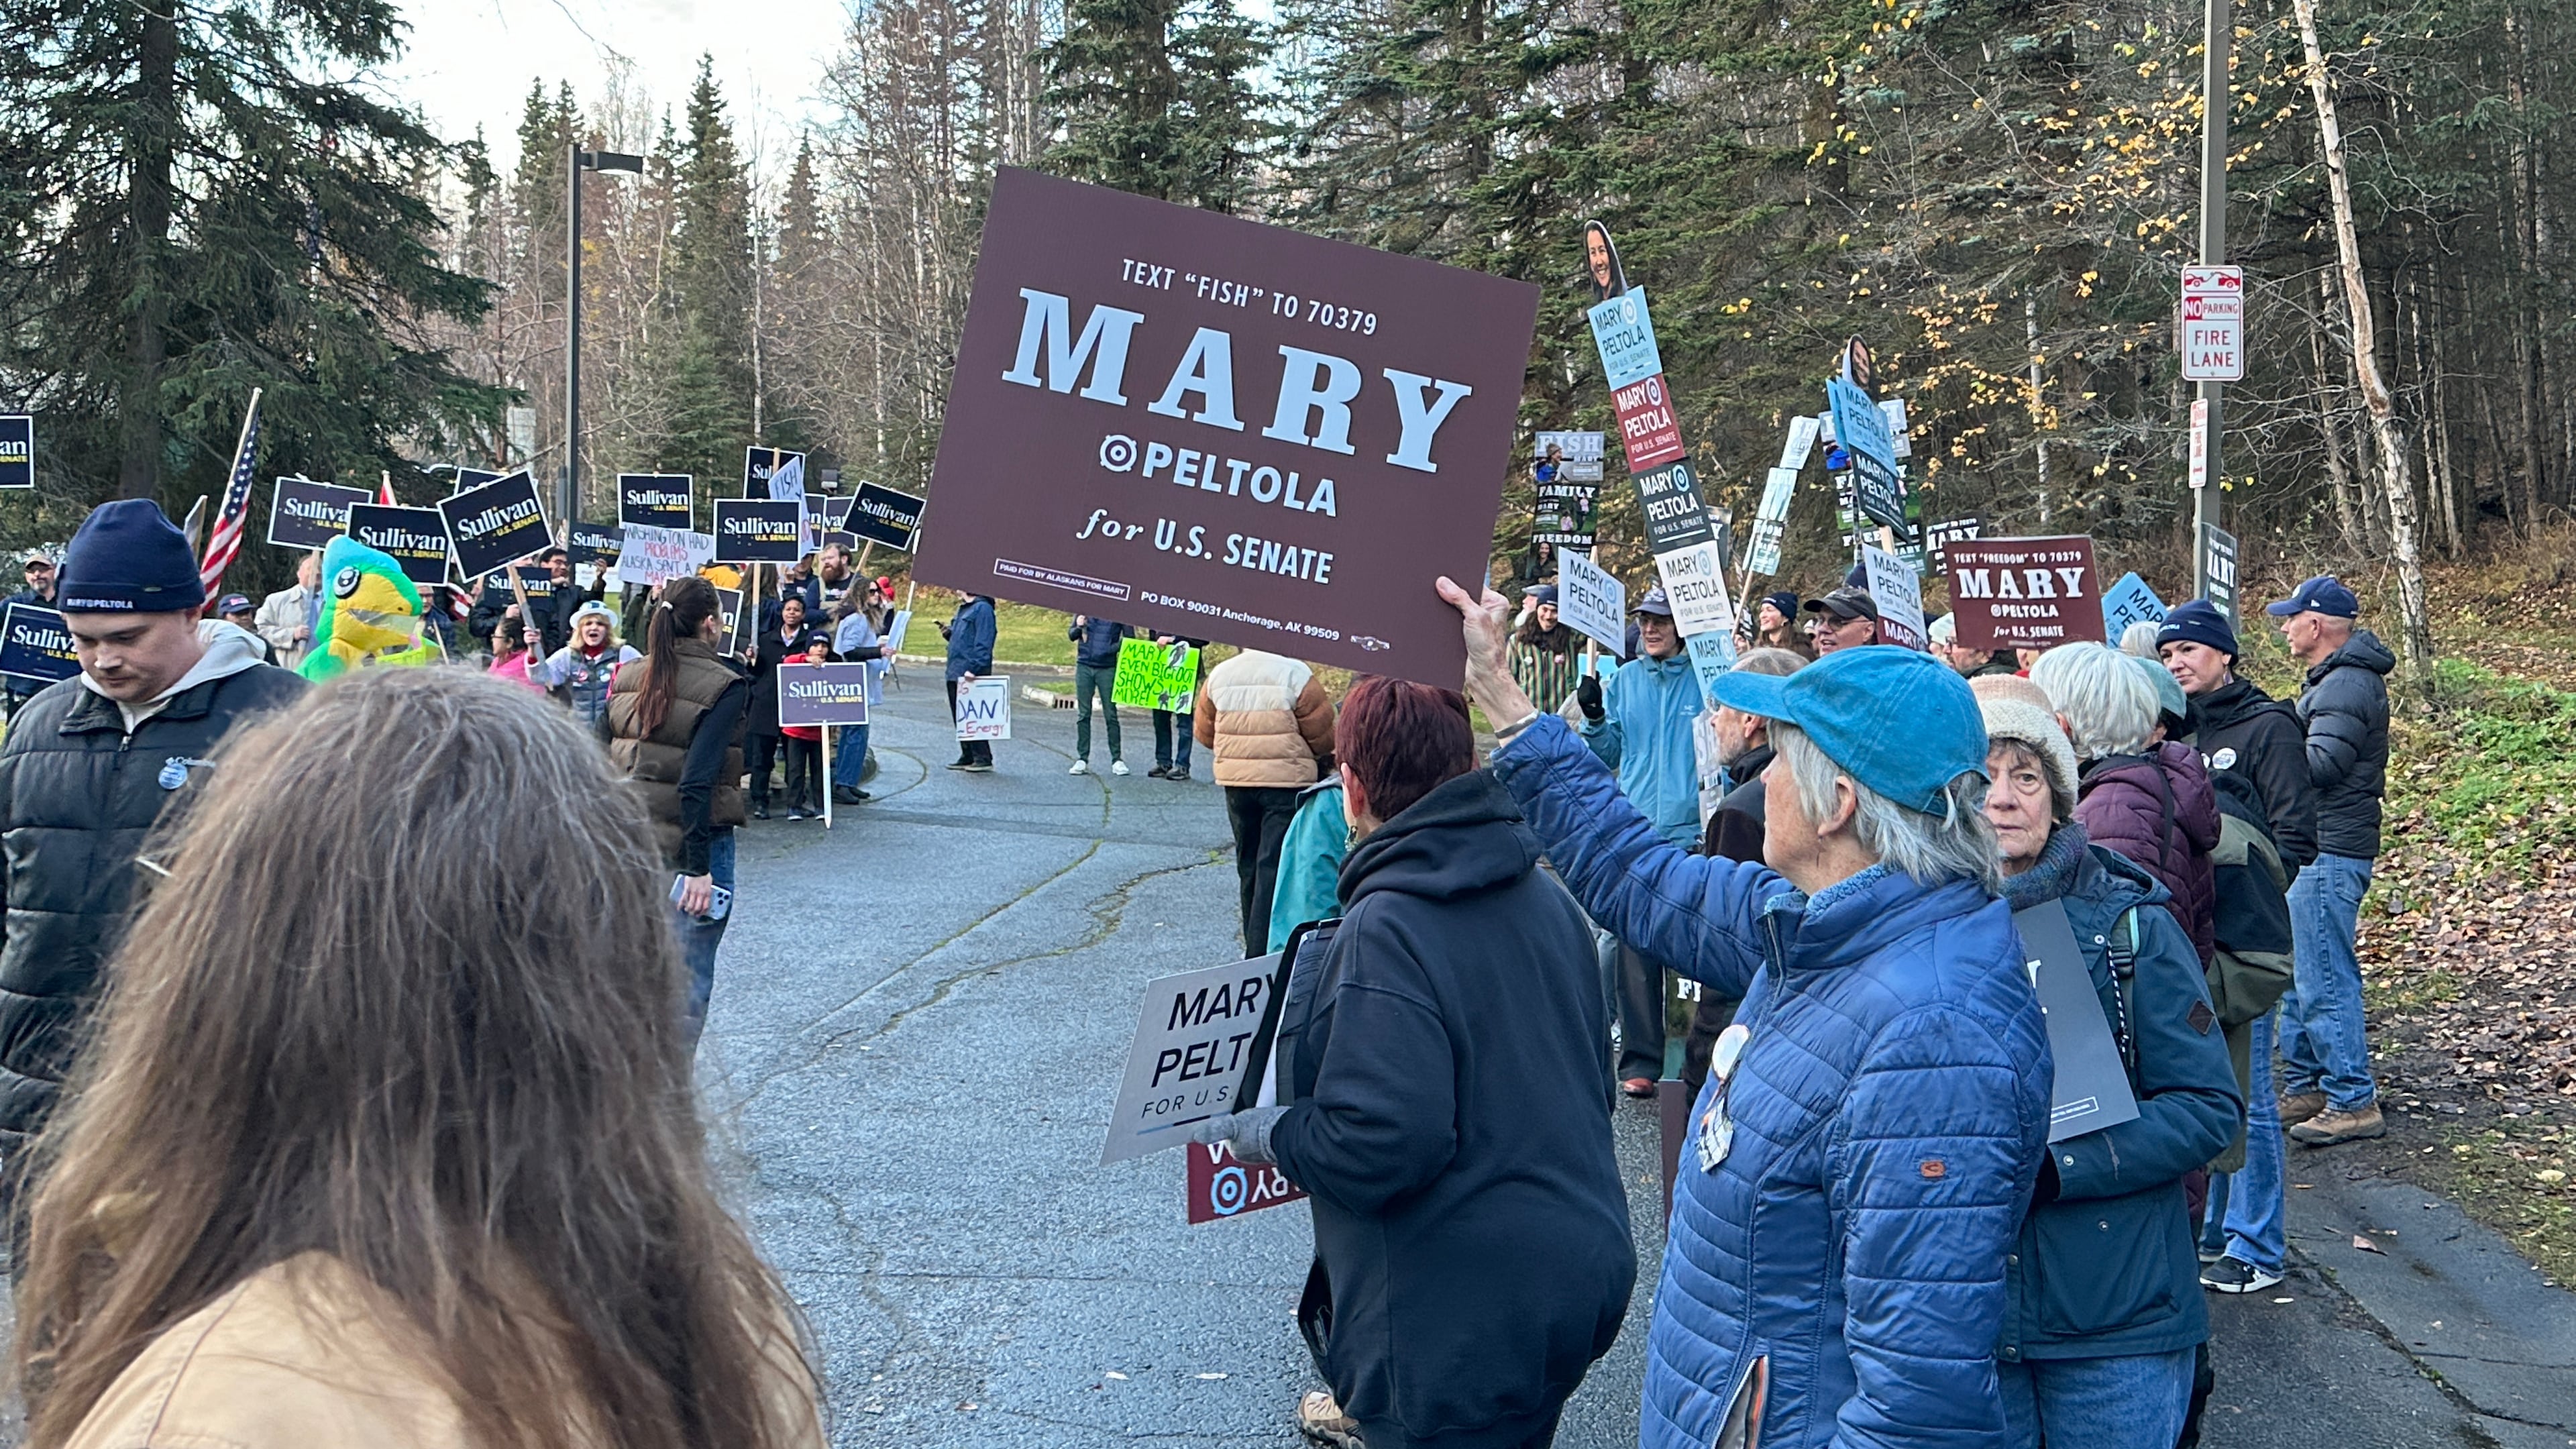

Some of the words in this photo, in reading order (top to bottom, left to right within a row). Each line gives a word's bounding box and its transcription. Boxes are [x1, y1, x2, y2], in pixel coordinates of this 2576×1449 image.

[1122, 258, 1175, 290] TEXT
[1185, 273, 1264, 307] “FISH”
[1273, 292, 1299, 318] TO
[1307, 299, 1377, 336] 70379
[2185, 301, 2202, 316] NO
[2203, 302, 2239, 314] PARKING
[1595, 304, 1623, 333] MARY
[1602, 325, 1646, 358] PELTOLA
[2194, 330, 2231, 346] FIRE
[2191, 352, 2235, 368] LANE
[1002, 286, 1472, 474] MARY
[1616, 383, 1647, 413] MARY
[1845, 386, 1872, 414] MARY
[1624, 407, 1672, 439] PELTOLA
[1538, 435, 1601, 452] FISH
[1631, 442, 1644, 454] FOR
[1141, 441, 1337, 517] PELTOLA
[1856, 453, 1885, 483] MARY
[775, 466, 798, 500] FISH
[1538, 485, 1596, 498] FAMILY
[1639, 470, 1673, 496] MARY
[1860, 475, 1901, 515] PELTOLA
[627, 489, 688, 505] Sullivan
[1646, 492, 1700, 522] PELTOLA
[284, 497, 349, 523] Sulliva
[458, 498, 537, 541] Sullivan
[857, 498, 916, 527] Sullivan
[333, 522, 348, 530] SEN
[496, 525, 512, 536] U.S.
[512, 513, 541, 531] SENATE
[724, 517, 796, 535] Sullivan
[1653, 525, 1667, 535] FOR
[1667, 522, 1680, 532] U.S.
[1680, 515, 1704, 529] SENATE
[359, 525, 445, 551] Sullivan
[572, 531, 623, 550] Sullivan
[624, 525, 686, 547] WASHINGTON
[689, 535, 709, 550] HAD
[1075, 508, 1144, 541] for
[1154, 518, 1213, 560] U.S.
[1222, 533, 1334, 584] SENATE
[1532, 533, 1593, 544] FREEDOM
[394, 549, 411, 557] U.S.
[413, 550, 444, 559] SENATE
[621, 555, 653, 571] ALASKA
[685, 562, 692, 575] A
[1665, 554, 1698, 578] MARY
[1954, 553, 1977, 564] TEXT
[2032, 553, 2047, 563] TO
[2049, 551, 2082, 562] 70379
[1000, 564, 1018, 574] PAID
[1018, 568, 1034, 577] FOR
[1034, 572, 1046, 580] BY
[1046, 573, 1085, 588] ALASKANS
[1086, 581, 1102, 591] FOR
[1103, 584, 1126, 595] MARY
[1570, 559, 1604, 591] MARY
[1874, 553, 1905, 581] MARY
[489, 574, 551, 590] Sulvan
[1673, 579, 1721, 604] PELTOLA
[1877, 576, 1919, 610] PELTOLA
[1955, 567, 2085, 599] MARY
[1140, 591, 1159, 603] PO
[1159, 595, 1185, 609] BOX
[1187, 600, 1221, 617] 90031
[1222, 608, 1283, 631] Anchorage,
[1285, 621, 1301, 633] AK
[1303, 624, 1340, 641] 99509
[1568, 602, 1583, 615] FOR
[1569, 582, 1619, 625] PELTOLA
[1680, 607, 1693, 617] FOR
[2002, 604, 2059, 618] PELTOLA
[2129, 588, 2164, 624] MAR
[11, 625, 77, 653] Sulliv
[1883, 619, 1917, 649] MARY
[1993, 626, 2010, 638] for
[2012, 626, 2029, 637] U.S.
[2029, 625, 2064, 637] SENATE
[47, 649, 64, 658] U.S.
[1122, 643, 1163, 661] MARY
[1694, 637, 1722, 659] MARY
[1120, 657, 1150, 673] EVEN
[1152, 661, 1195, 684] BIGFOOT
[1701, 664, 1730, 684] PELTO
[788, 680, 862, 698] Sullivan
[1114, 688, 1150, 706] MORE!
[1116, 671, 1164, 695] SHOWS
[1169, 684, 1188, 698] UP
[957, 699, 999, 722] DAN
[966, 720, 1004, 737] Energy
[1150, 1032, 1253, 1088] PELT
[1141, 1094, 1185, 1118] FOR
[1194, 1085, 1234, 1107] U.S.
